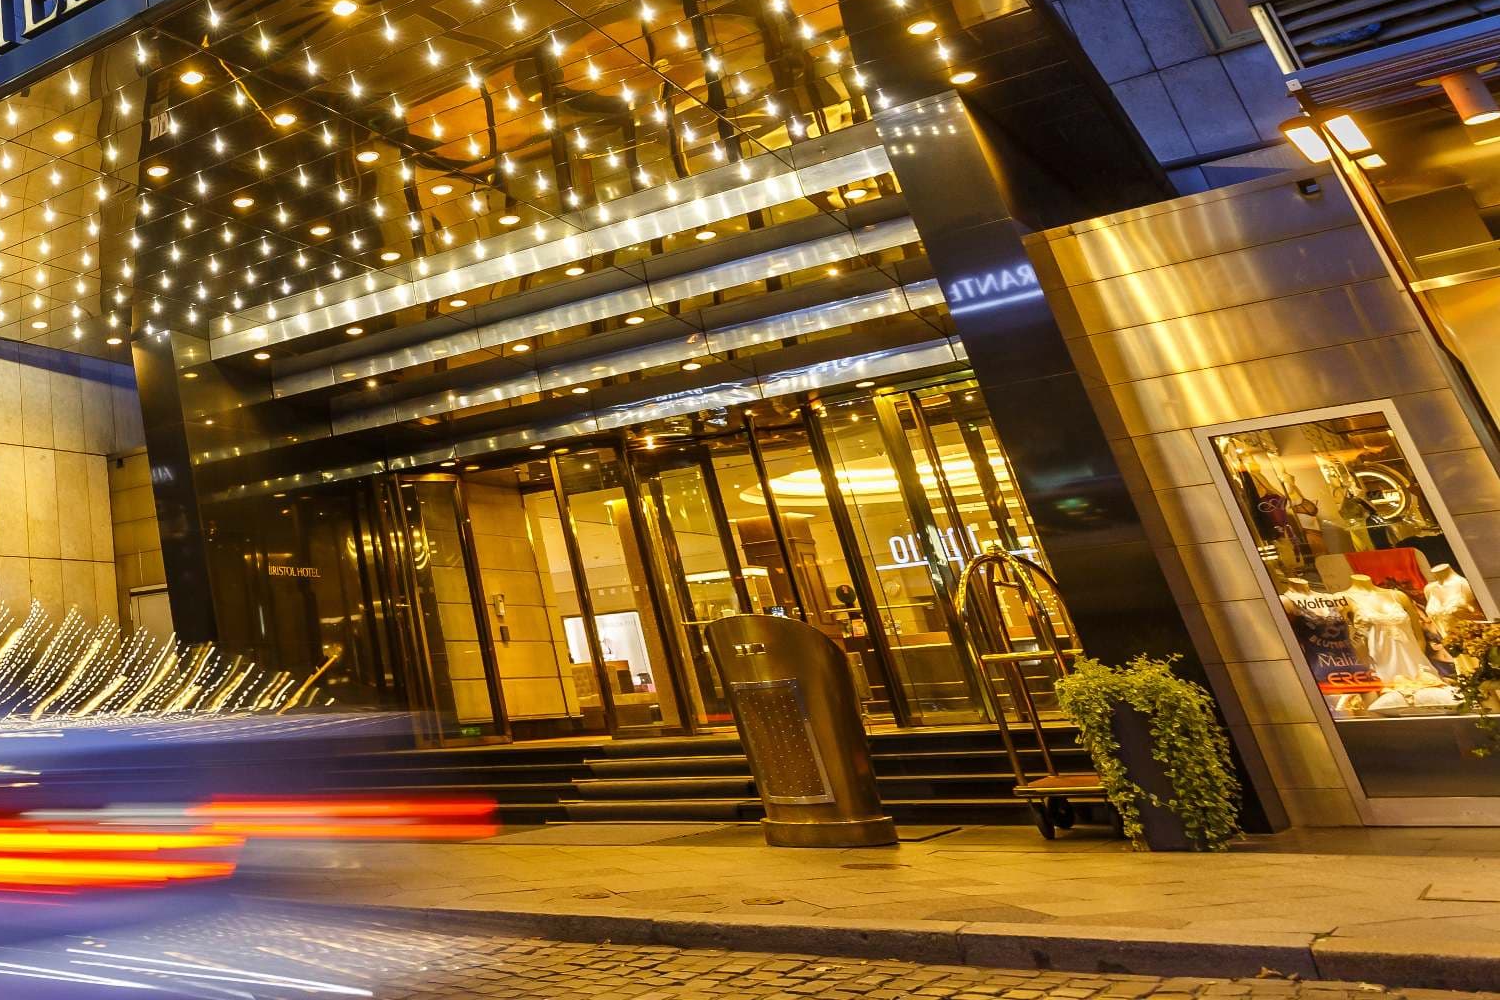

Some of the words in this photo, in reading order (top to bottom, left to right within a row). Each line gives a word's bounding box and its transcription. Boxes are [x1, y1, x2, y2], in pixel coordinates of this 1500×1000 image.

[268, 565, 296, 577] BRISTOL
[297, 567, 321, 577] HOTEL
[1295, 595, 1349, 611] Wolford
